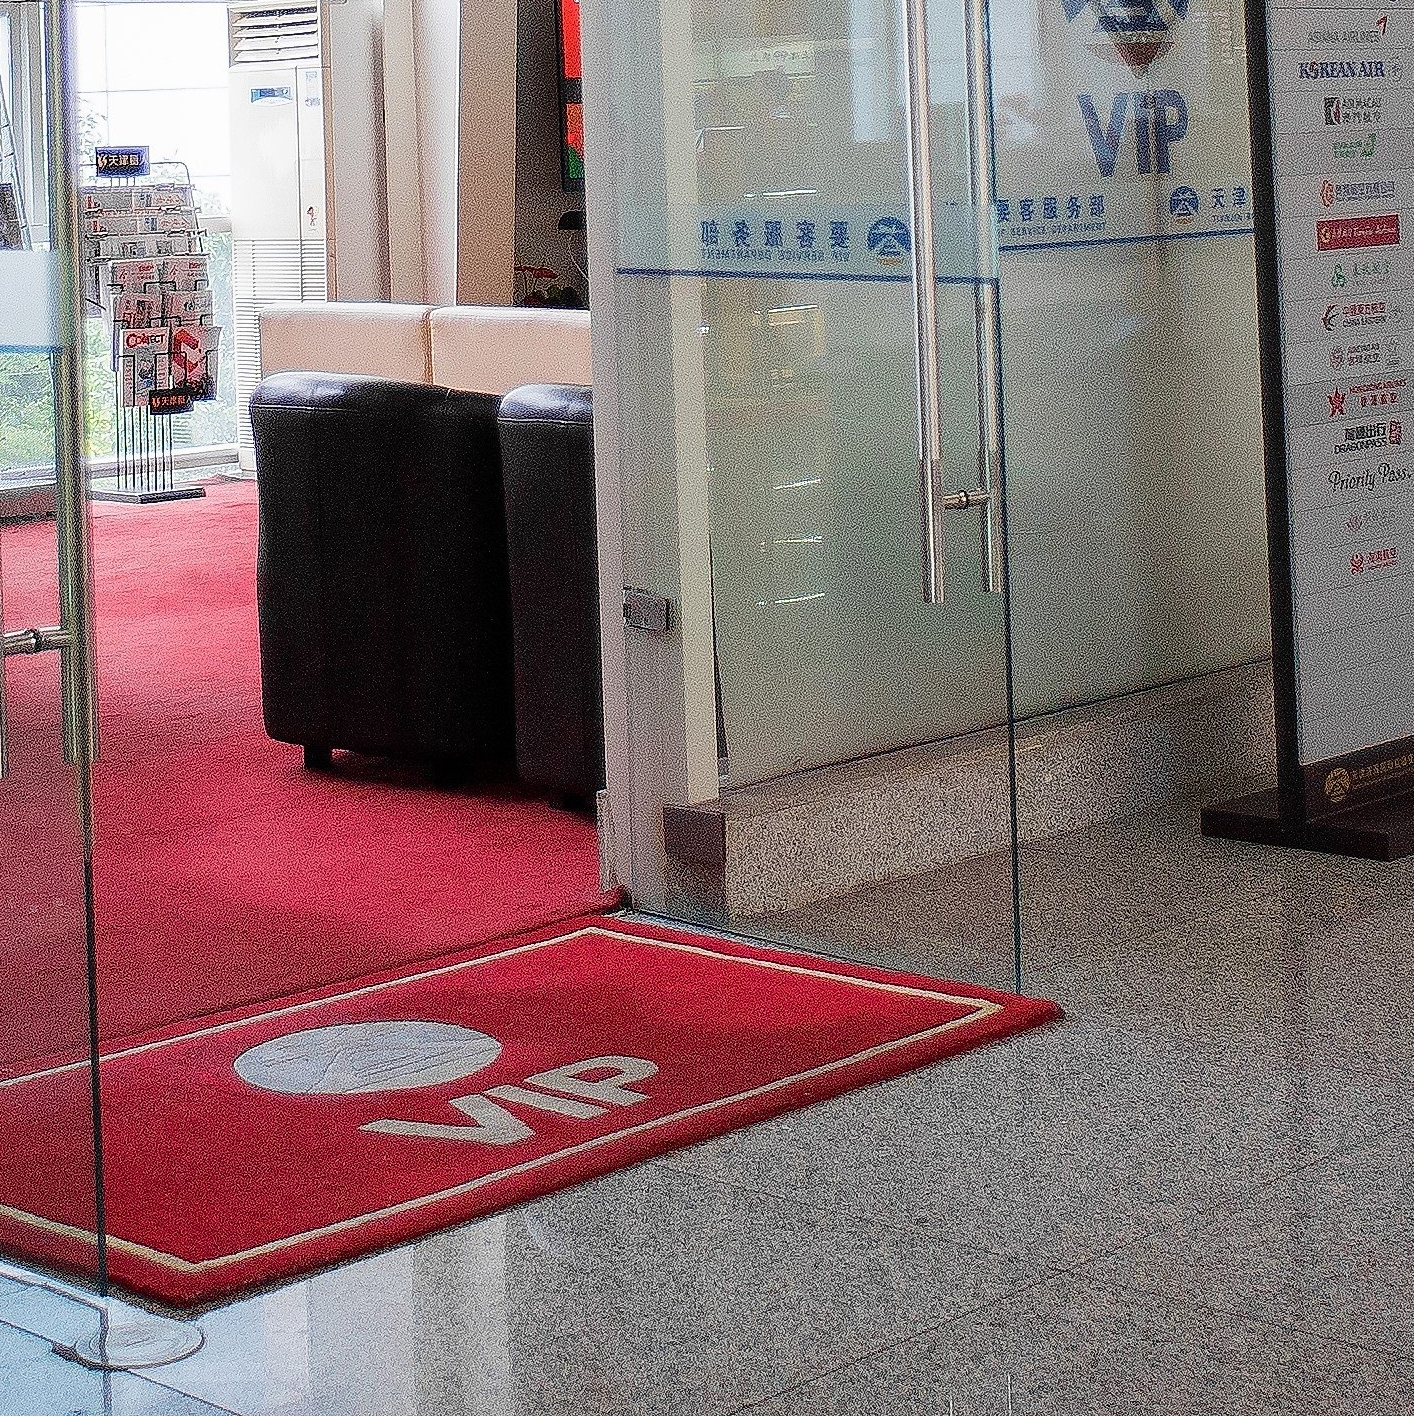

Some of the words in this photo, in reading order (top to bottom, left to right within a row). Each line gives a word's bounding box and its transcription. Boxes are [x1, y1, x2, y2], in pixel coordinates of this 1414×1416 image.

[1298, 60, 1357, 80] KOREAN
[1358, 60, 1386, 78] AIR
[1077, 89, 1189, 177] VIP
[1328, 469, 1376, 492] Priority
[356, 1054, 660, 1146] VIP
